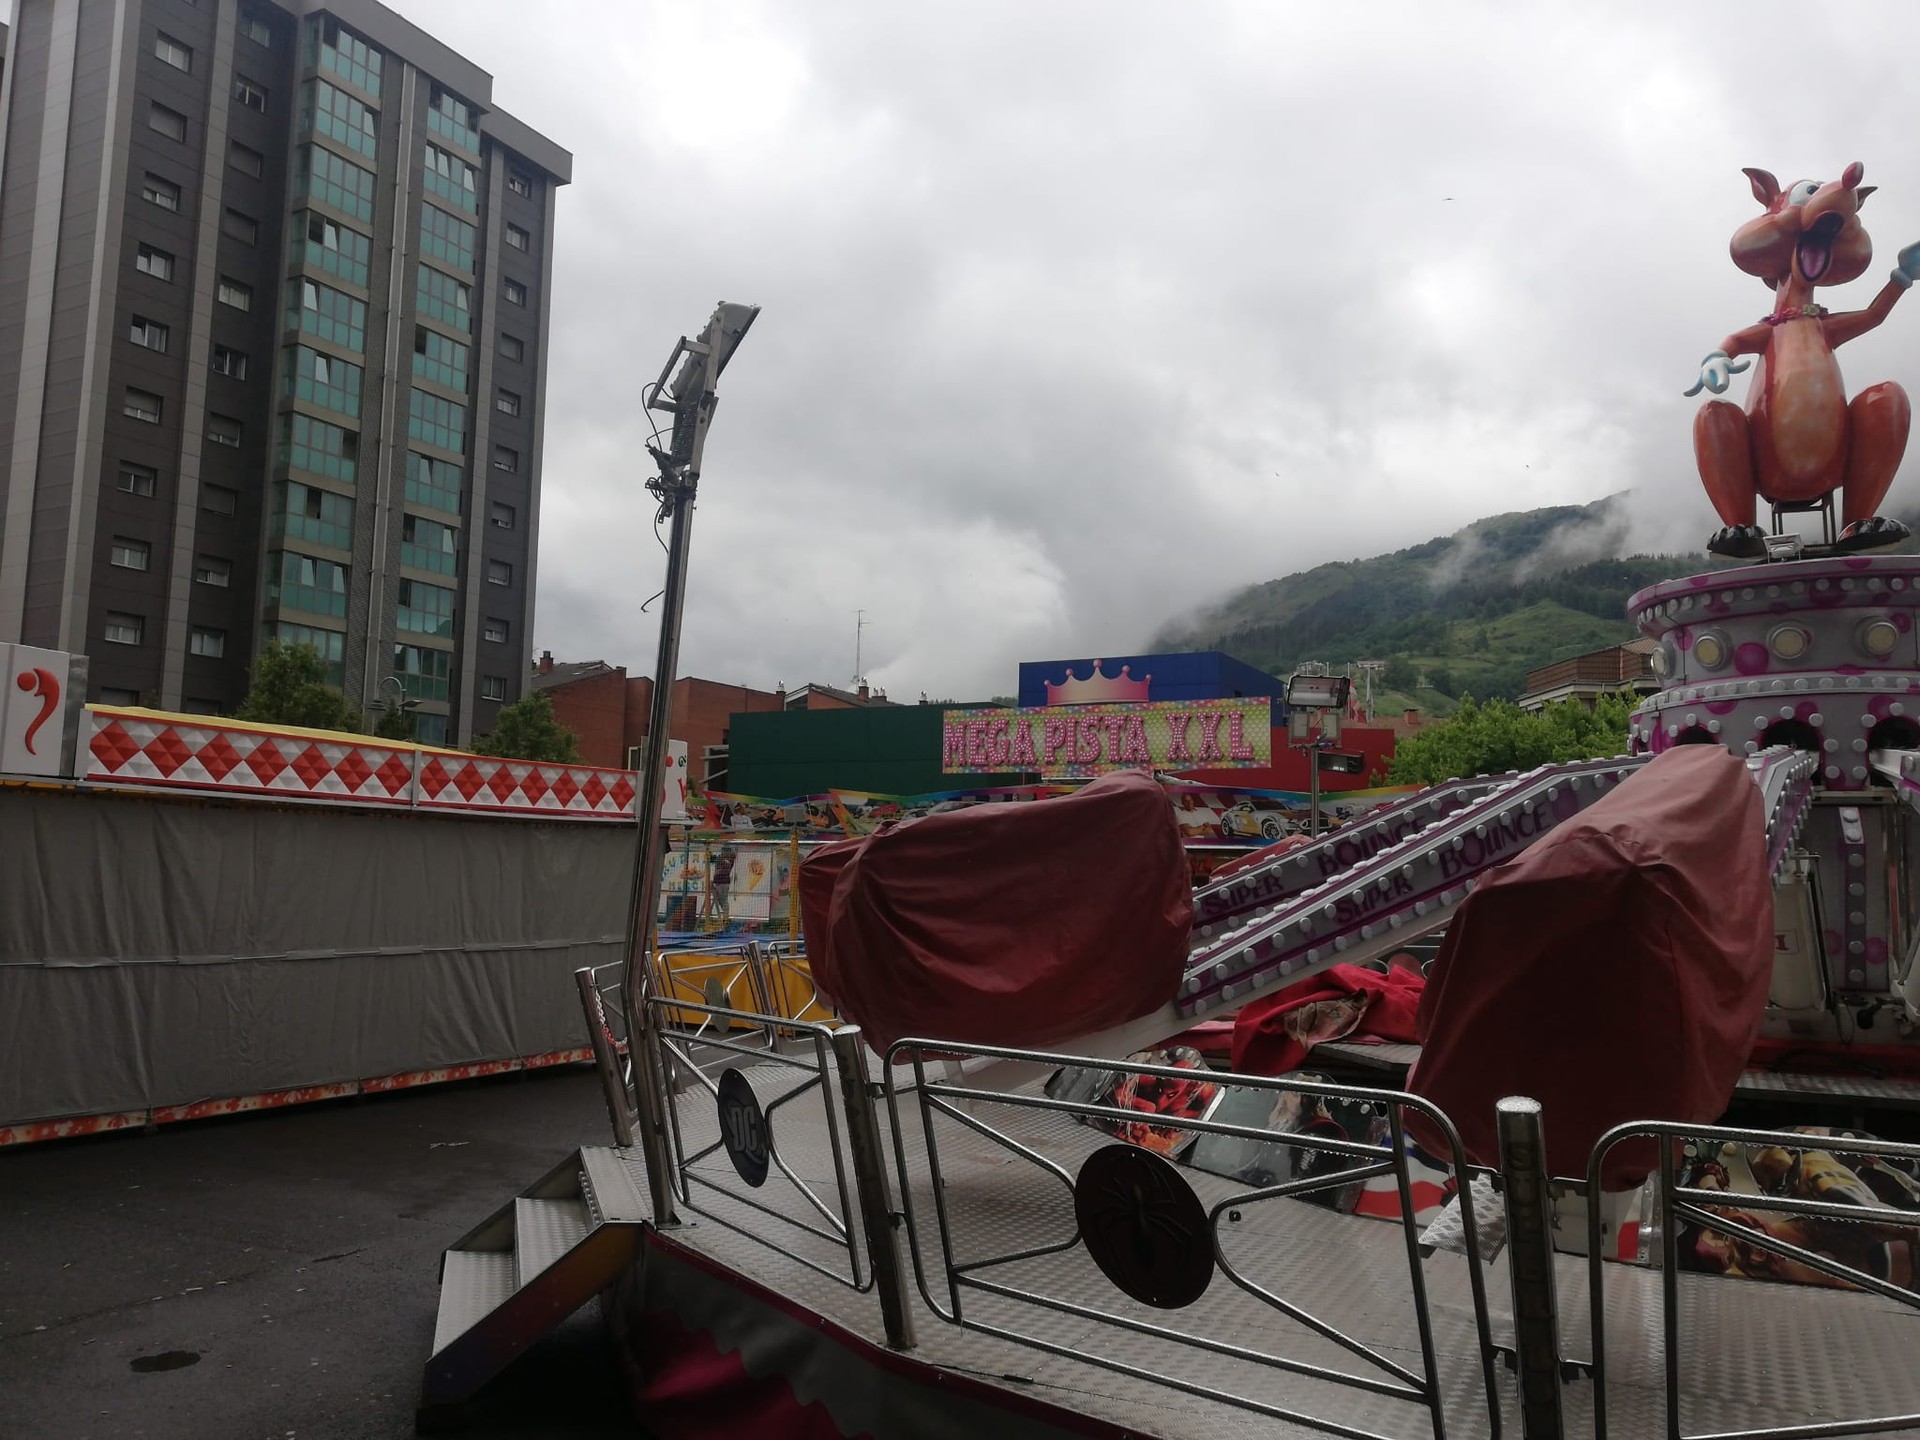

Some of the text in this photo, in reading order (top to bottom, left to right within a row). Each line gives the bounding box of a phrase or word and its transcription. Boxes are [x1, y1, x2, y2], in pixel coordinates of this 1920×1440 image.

[943, 710, 1254, 767] MEGA PISTA XXL
